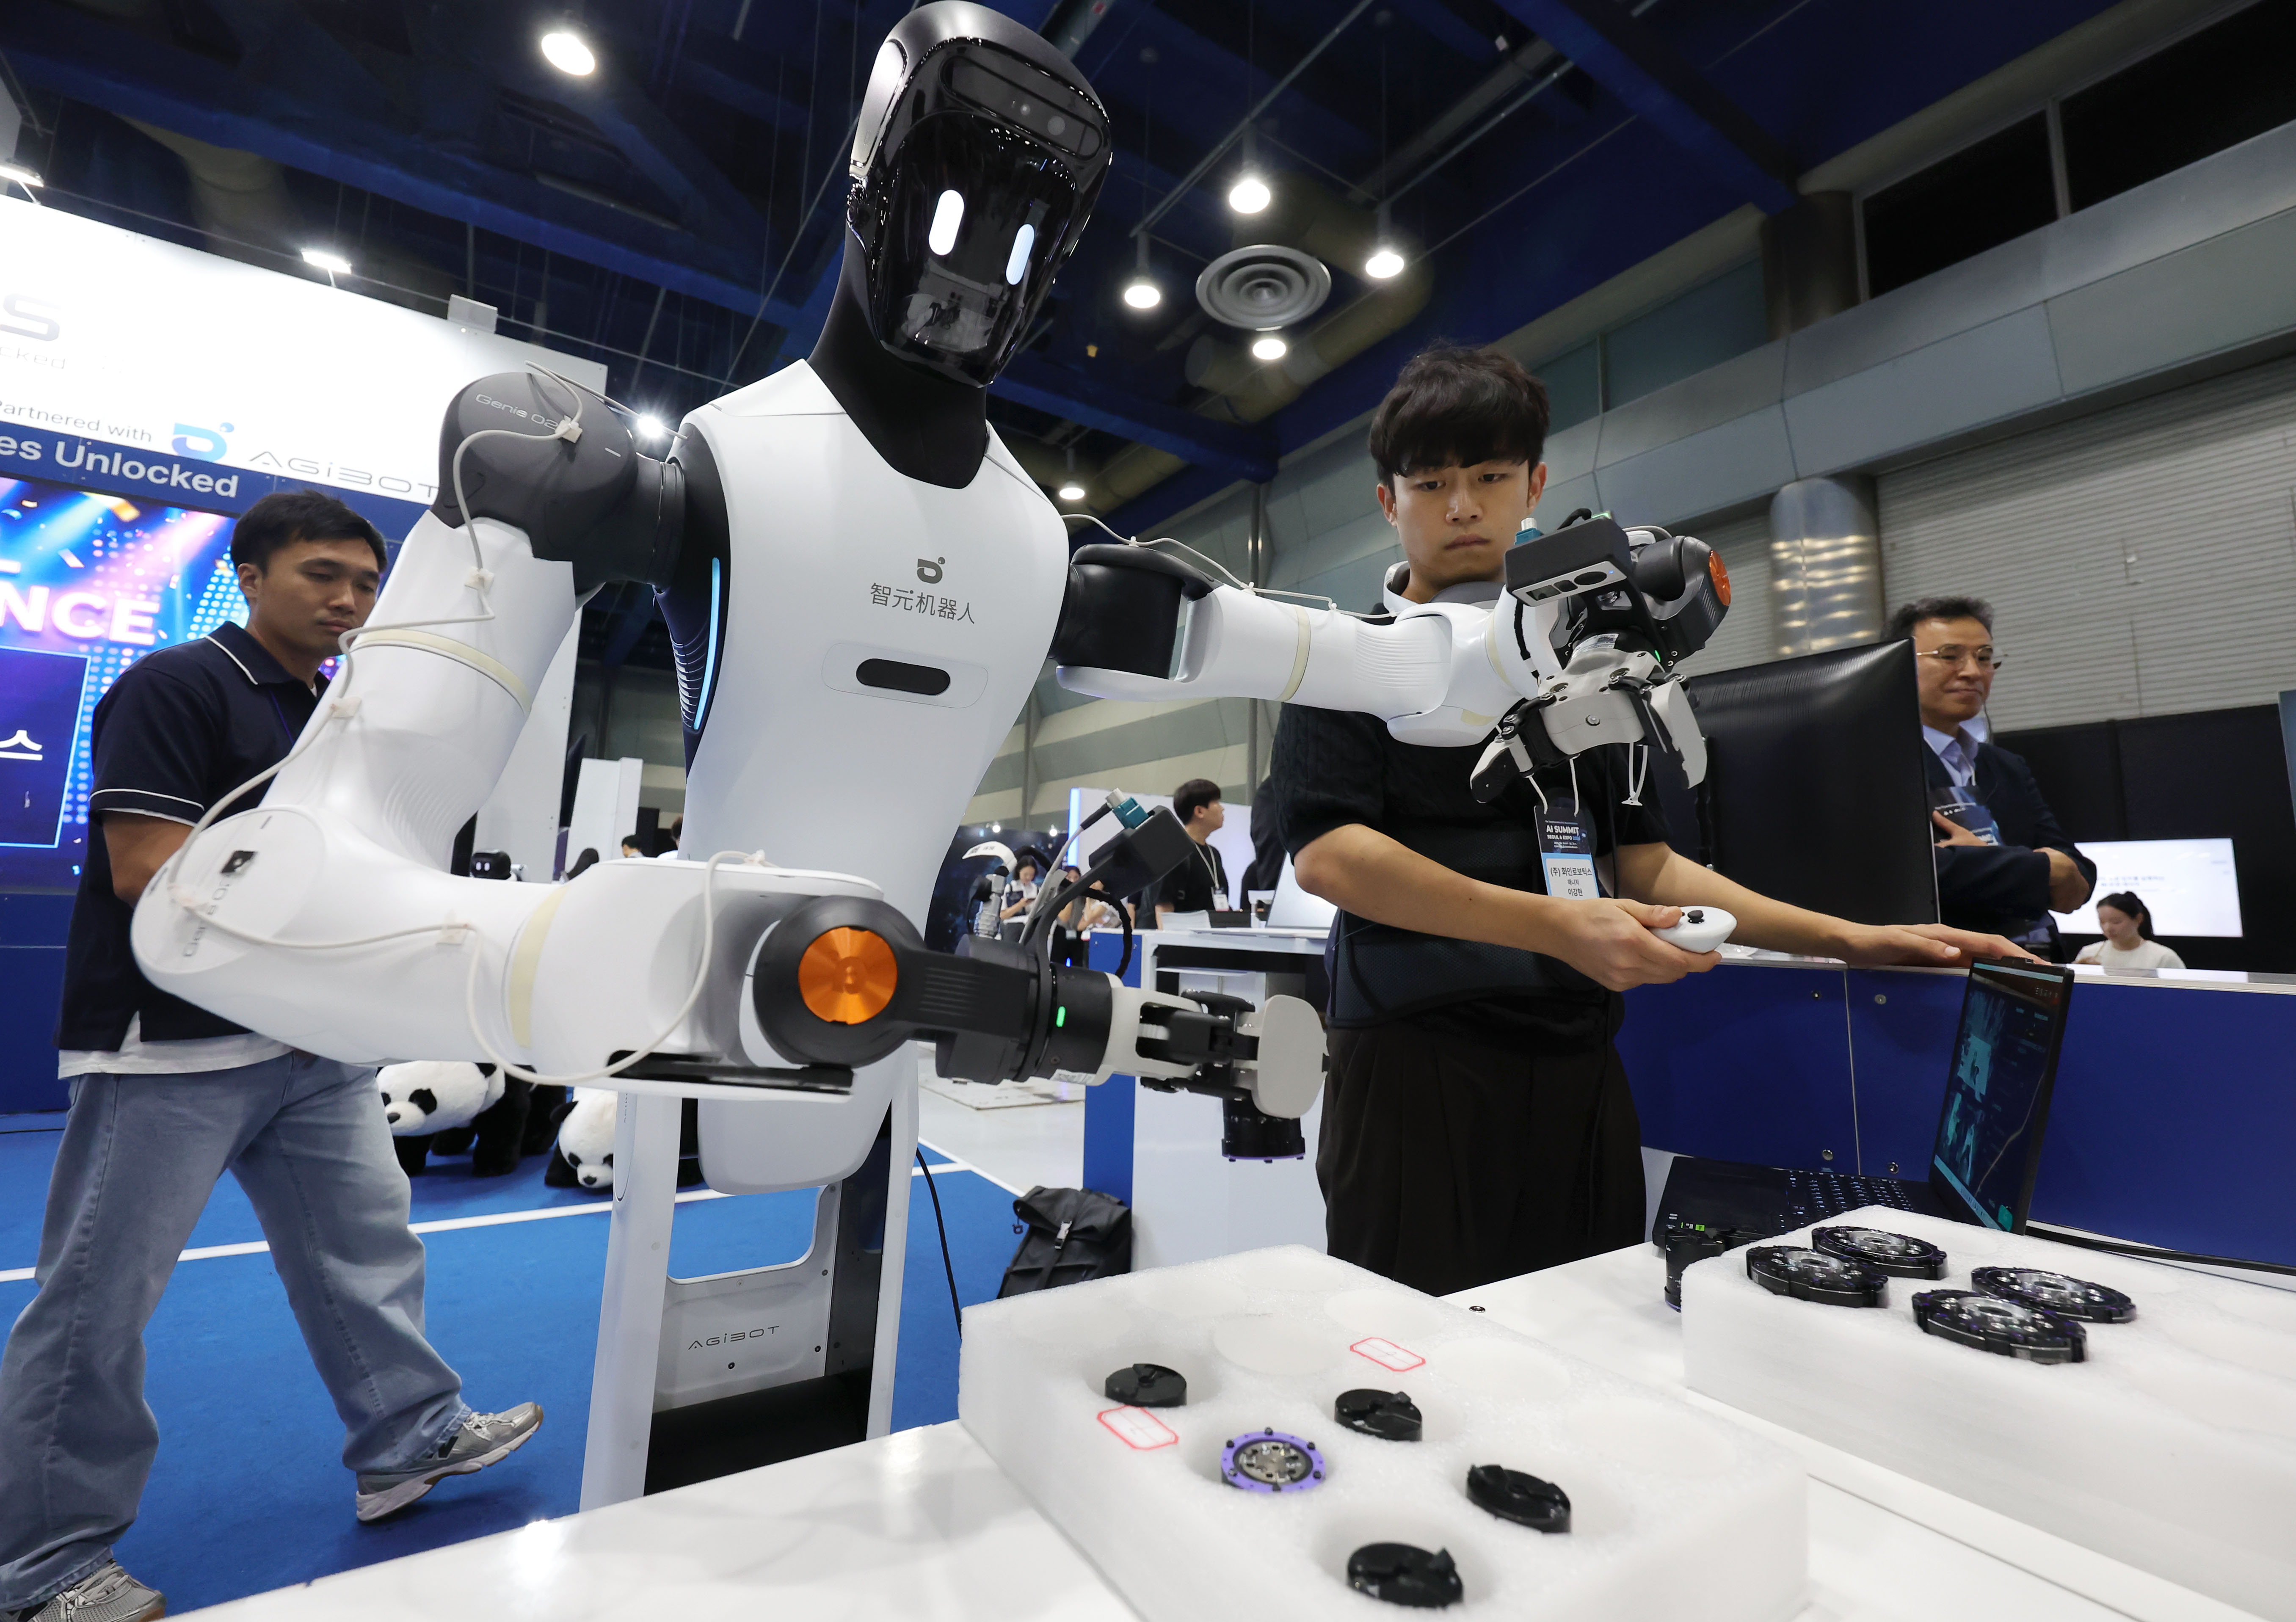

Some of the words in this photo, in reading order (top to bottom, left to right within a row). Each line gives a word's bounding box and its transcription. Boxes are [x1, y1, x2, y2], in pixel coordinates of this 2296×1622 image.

[476, 394, 527, 418] Genie
[531, 414, 558, 430] 02
[108, 425, 152, 442] with
[0, 436, 42, 461] es
[55, 441, 239, 498] Unlocked
[0, 581, 160, 645] NCE
[870, 582, 975, 624] 智元机器人
[1554, 825, 1579, 836] SUMMIT
[1551, 867, 1560, 877] (주)
[1562, 867, 1592, 876] 화인로보틱스
[1568, 888, 1583, 897] 이강현
